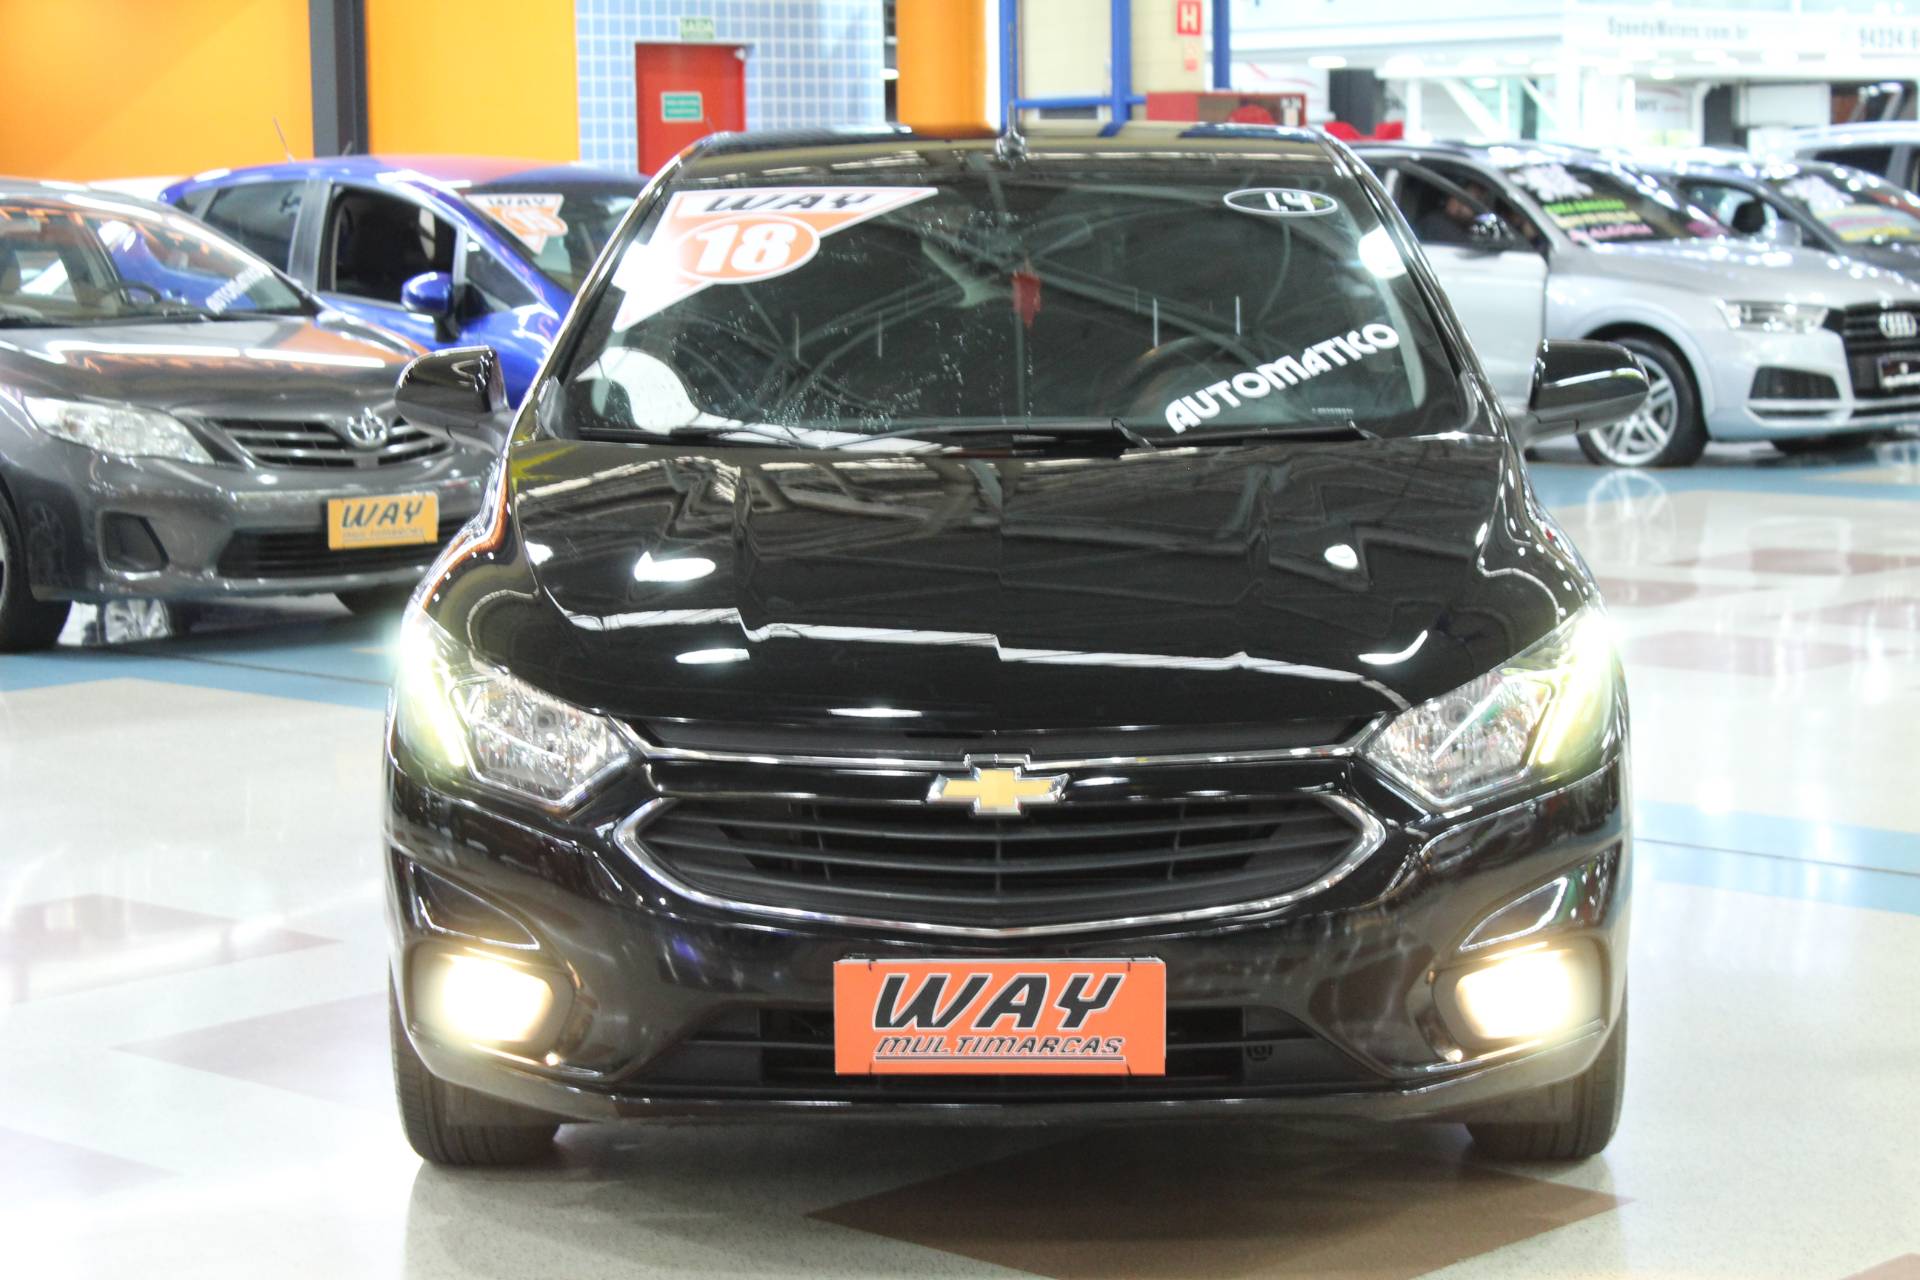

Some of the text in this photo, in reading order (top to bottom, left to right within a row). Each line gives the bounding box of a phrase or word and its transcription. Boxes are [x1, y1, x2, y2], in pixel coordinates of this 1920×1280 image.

[1180, 3, 1198, 32] H
[704, 192, 876, 213] WAY
[1265, 191, 1316, 212] 1.4
[695, 222, 798, 274] 18
[1165, 323, 1400, 431] AUTOMATICO
[341, 501, 424, 528] WAY
[872, 972, 1126, 1032] WAY
[875, 1035, 1126, 1055] MULTIMARCAS
